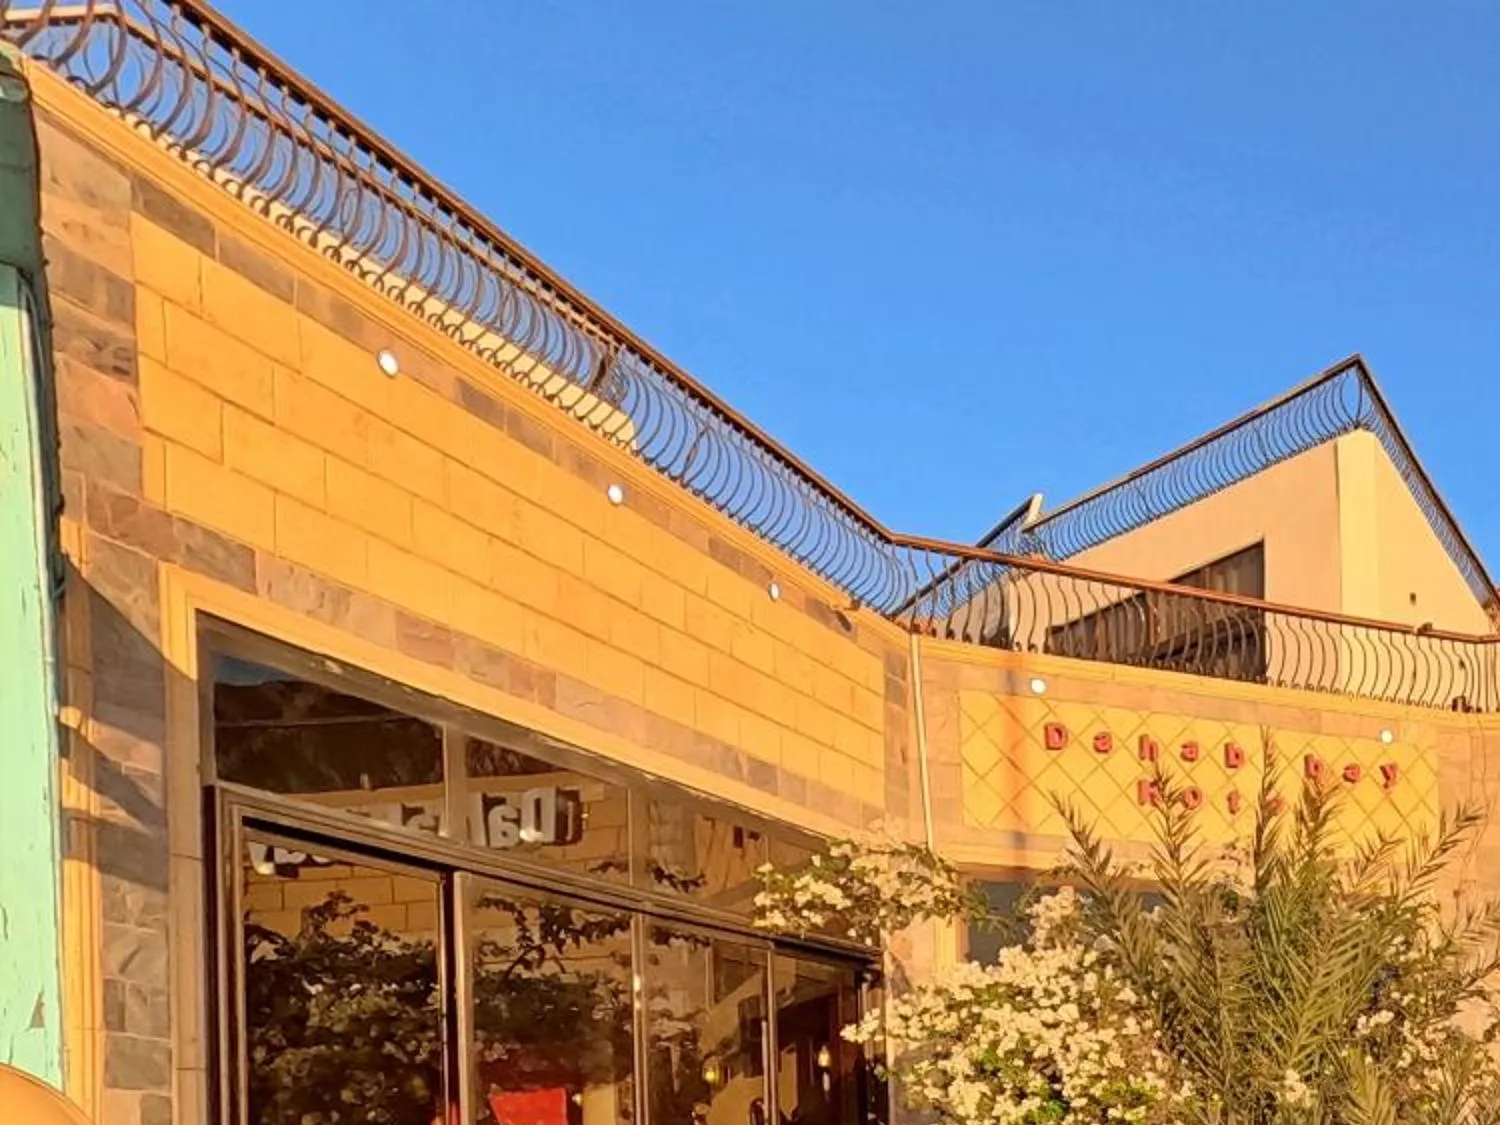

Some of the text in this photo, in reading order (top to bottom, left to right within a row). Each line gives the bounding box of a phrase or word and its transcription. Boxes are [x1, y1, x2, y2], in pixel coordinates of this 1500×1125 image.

[1044, 722, 1399, 790] Dahab bay
[1138, 779, 1284, 815] hot
